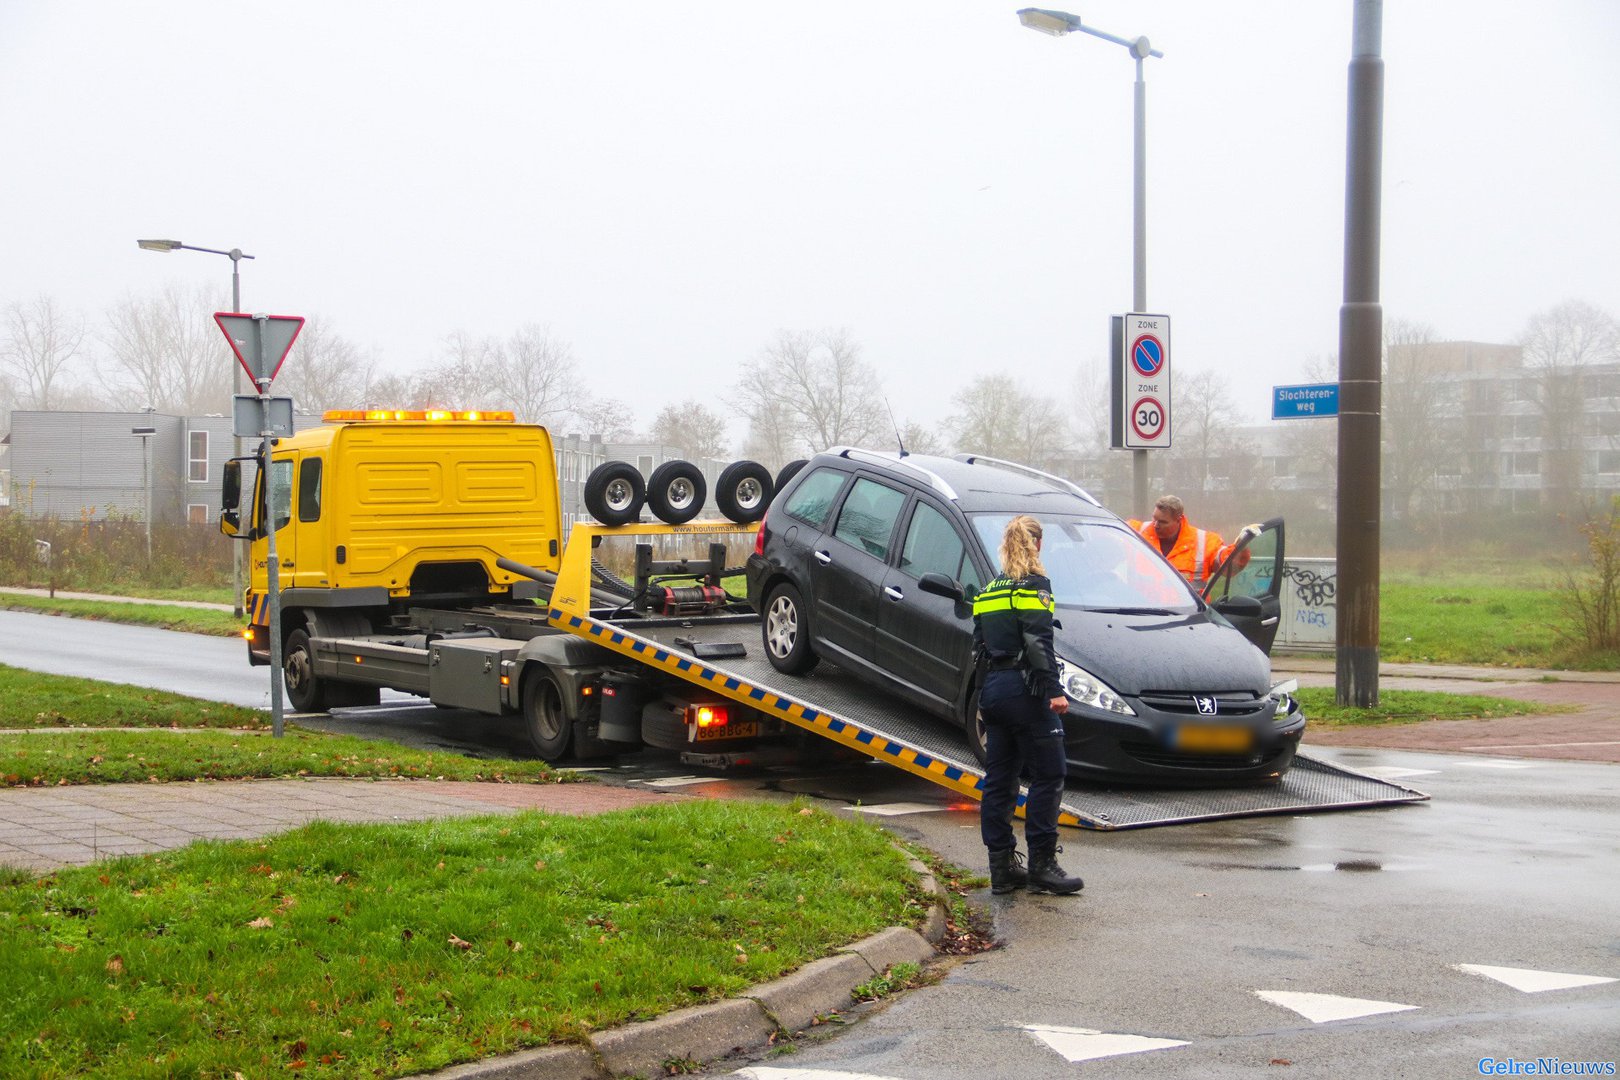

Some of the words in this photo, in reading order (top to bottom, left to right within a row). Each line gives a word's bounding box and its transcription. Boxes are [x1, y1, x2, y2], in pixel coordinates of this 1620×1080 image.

[1138, 321, 1158, 329] ZONE
[1279, 390, 1334, 400] Slochteren-
[1297, 403, 1315, 412] weg
[1138, 410, 1159, 426] 30
